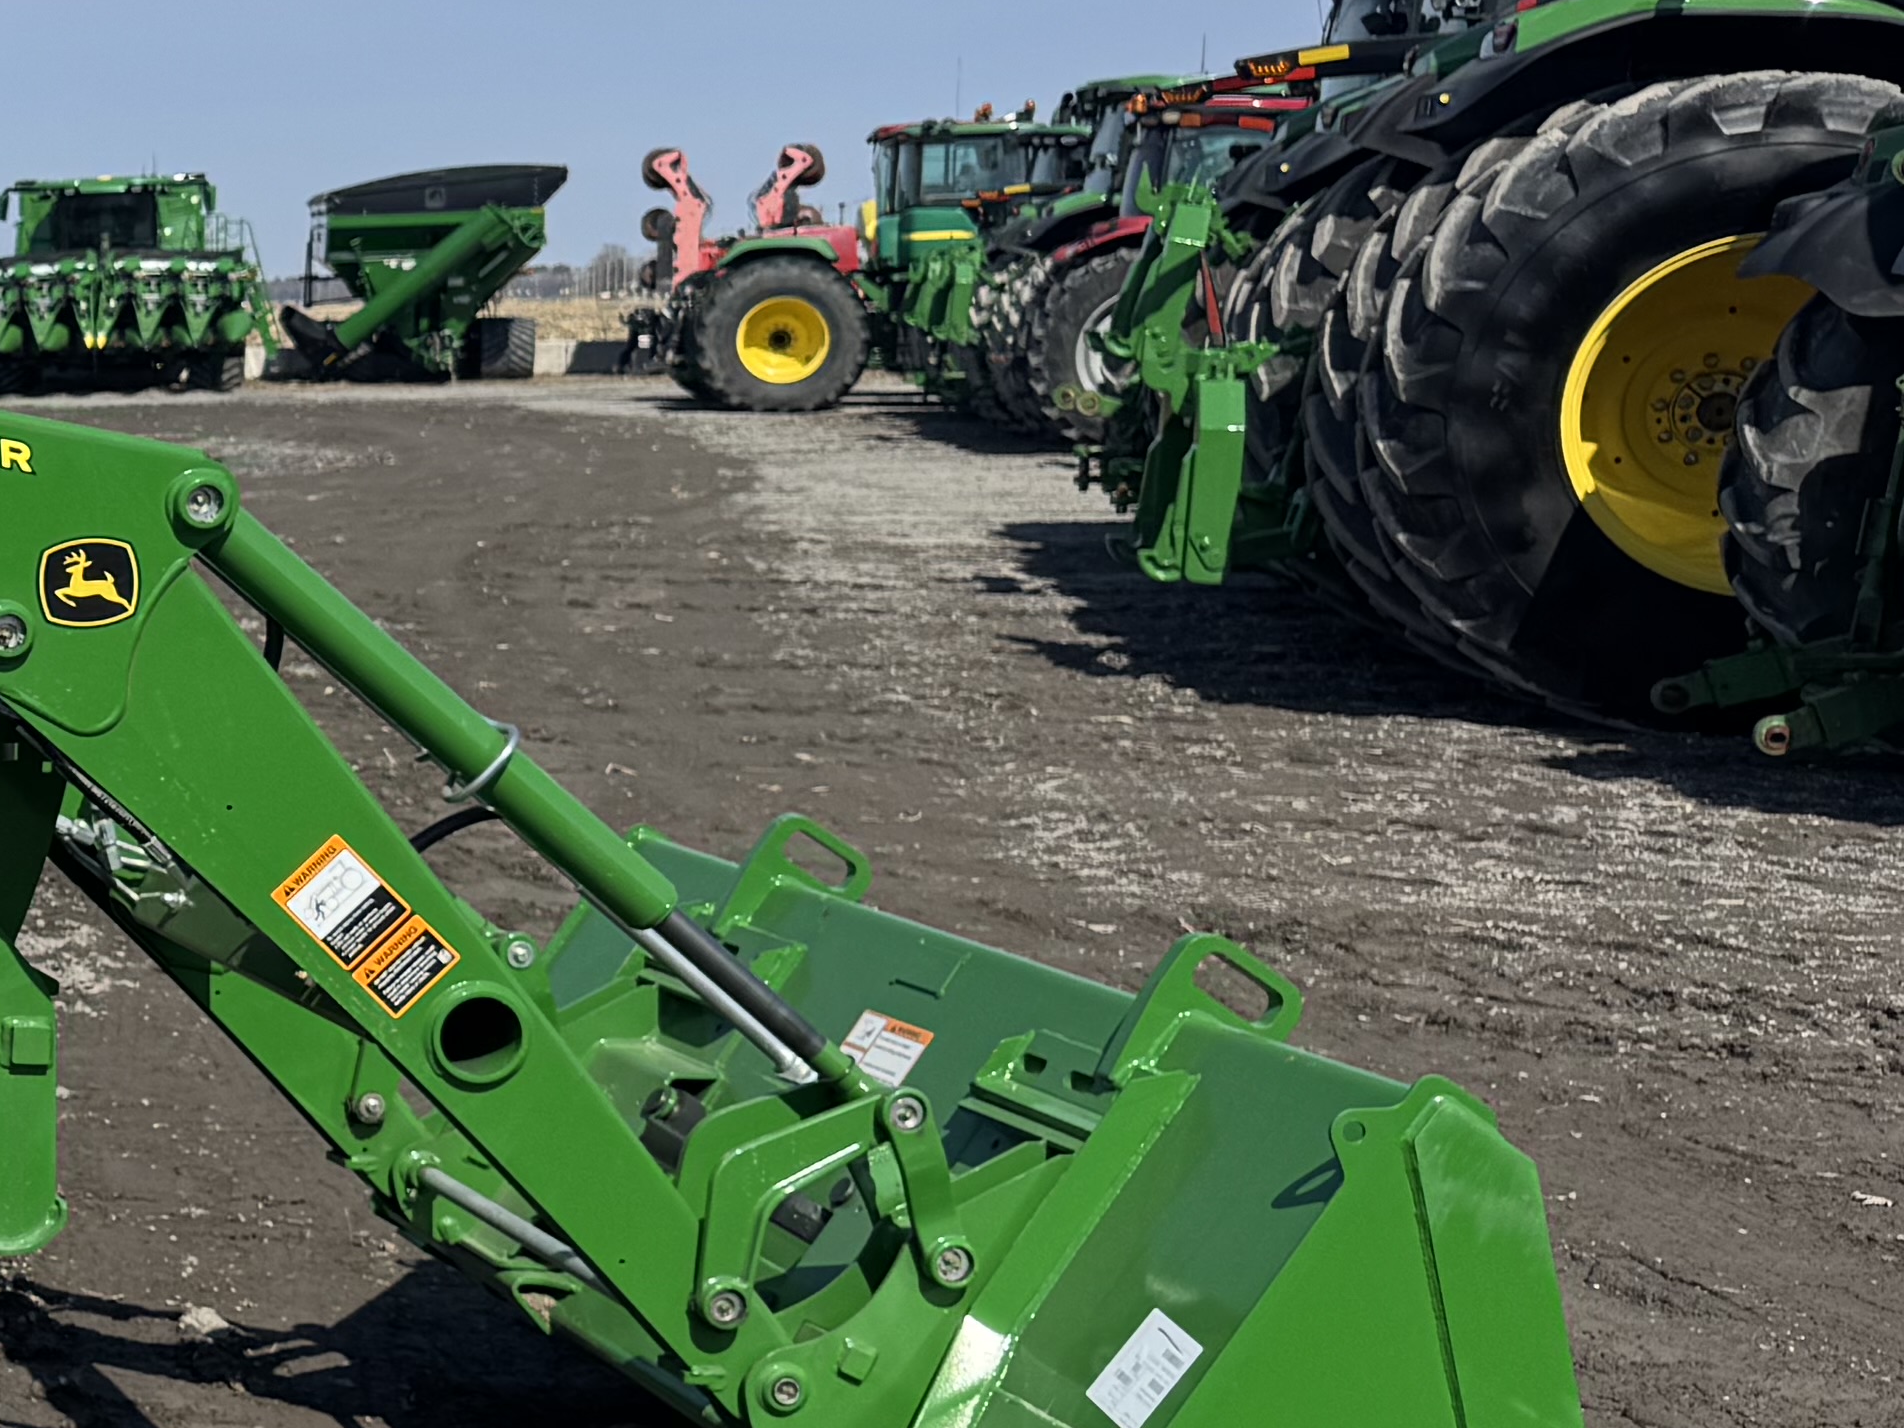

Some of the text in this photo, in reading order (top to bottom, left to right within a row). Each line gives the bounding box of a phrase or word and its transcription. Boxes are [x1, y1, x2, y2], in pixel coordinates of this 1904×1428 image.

[0, 436, 36, 475] R
[292, 844, 337, 887] WARNING
[374, 925, 418, 967] WARNING
